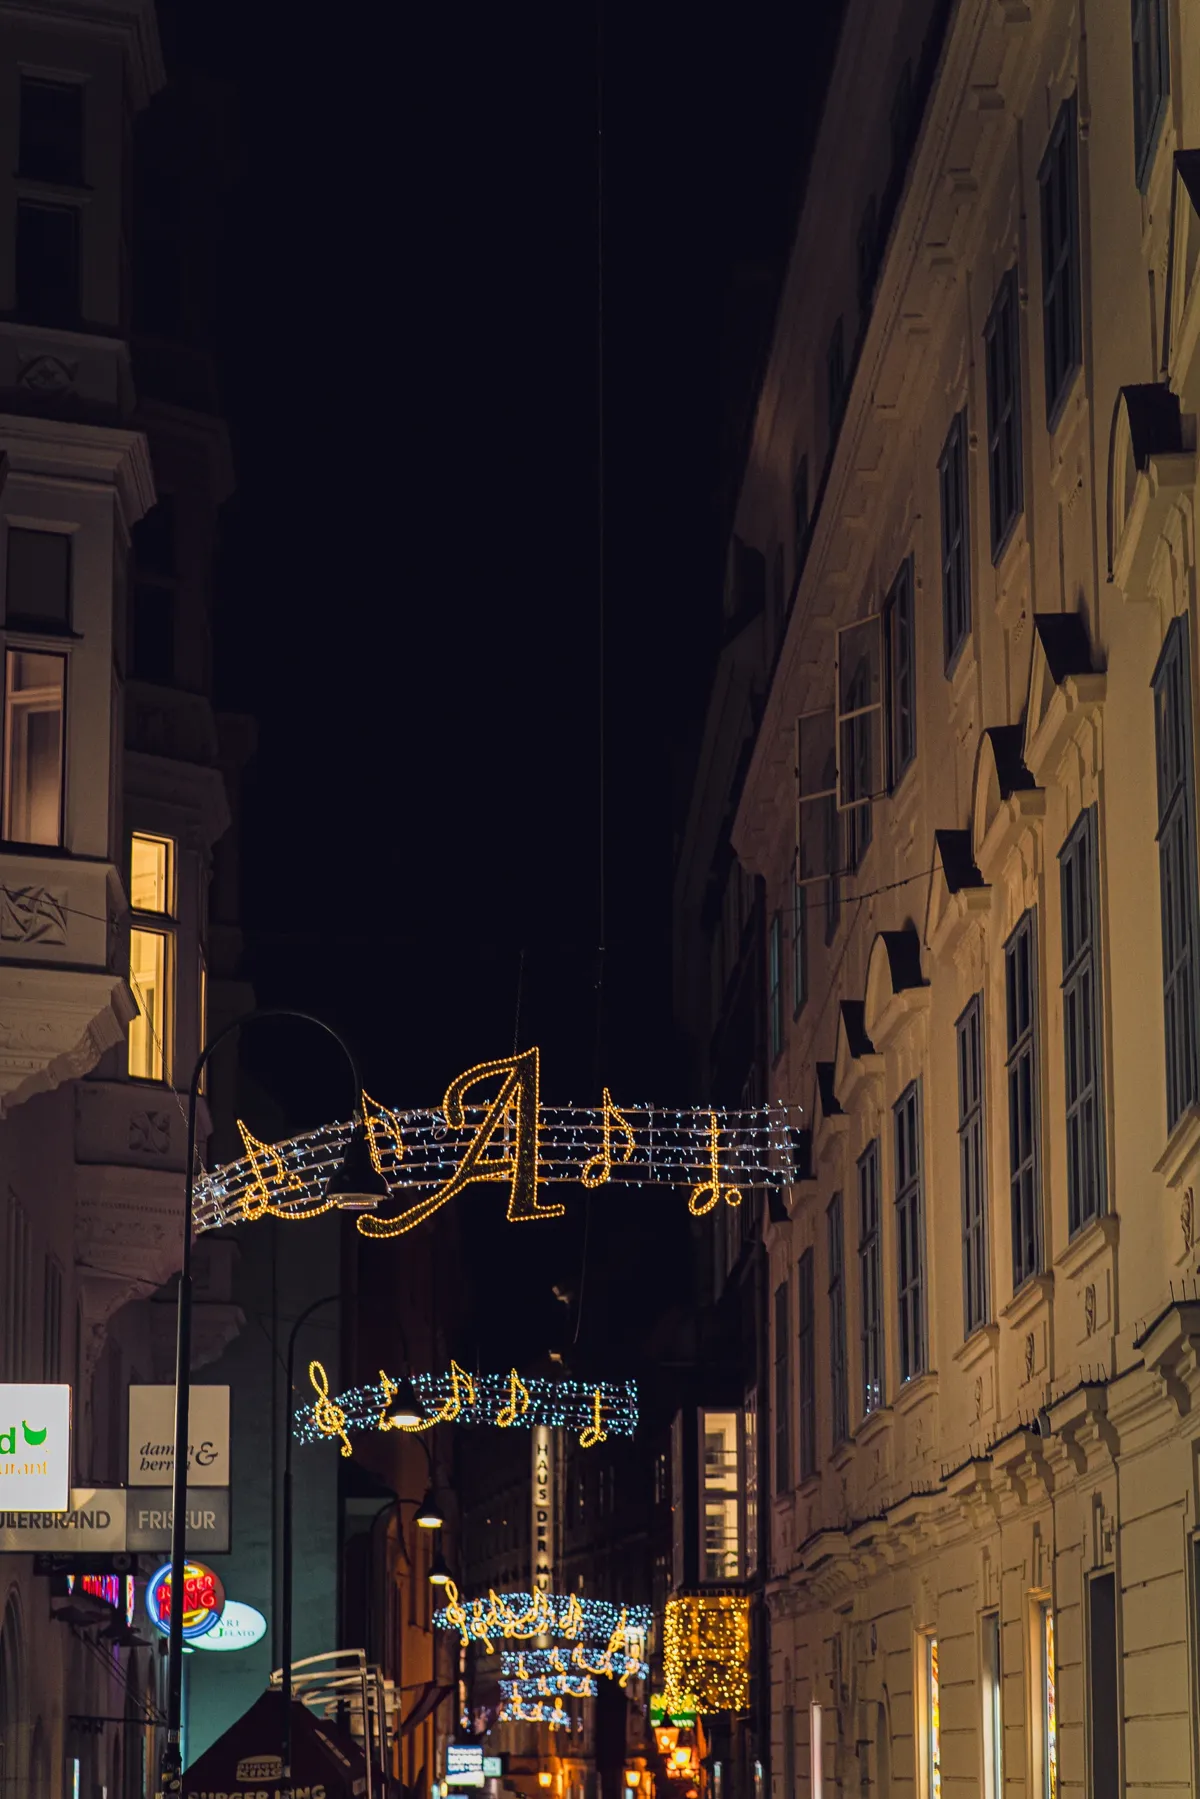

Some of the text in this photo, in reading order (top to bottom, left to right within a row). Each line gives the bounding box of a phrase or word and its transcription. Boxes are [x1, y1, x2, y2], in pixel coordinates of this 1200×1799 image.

[195, 1441, 219, 1467] &
[536, 1444, 548, 1500] HAUS
[138, 1510, 216, 1530] FRISUR
[537, 1511, 548, 1552] DER
[157, 1575, 214, 1602] BUGER
[160, 1589, 216, 1620] KNG
